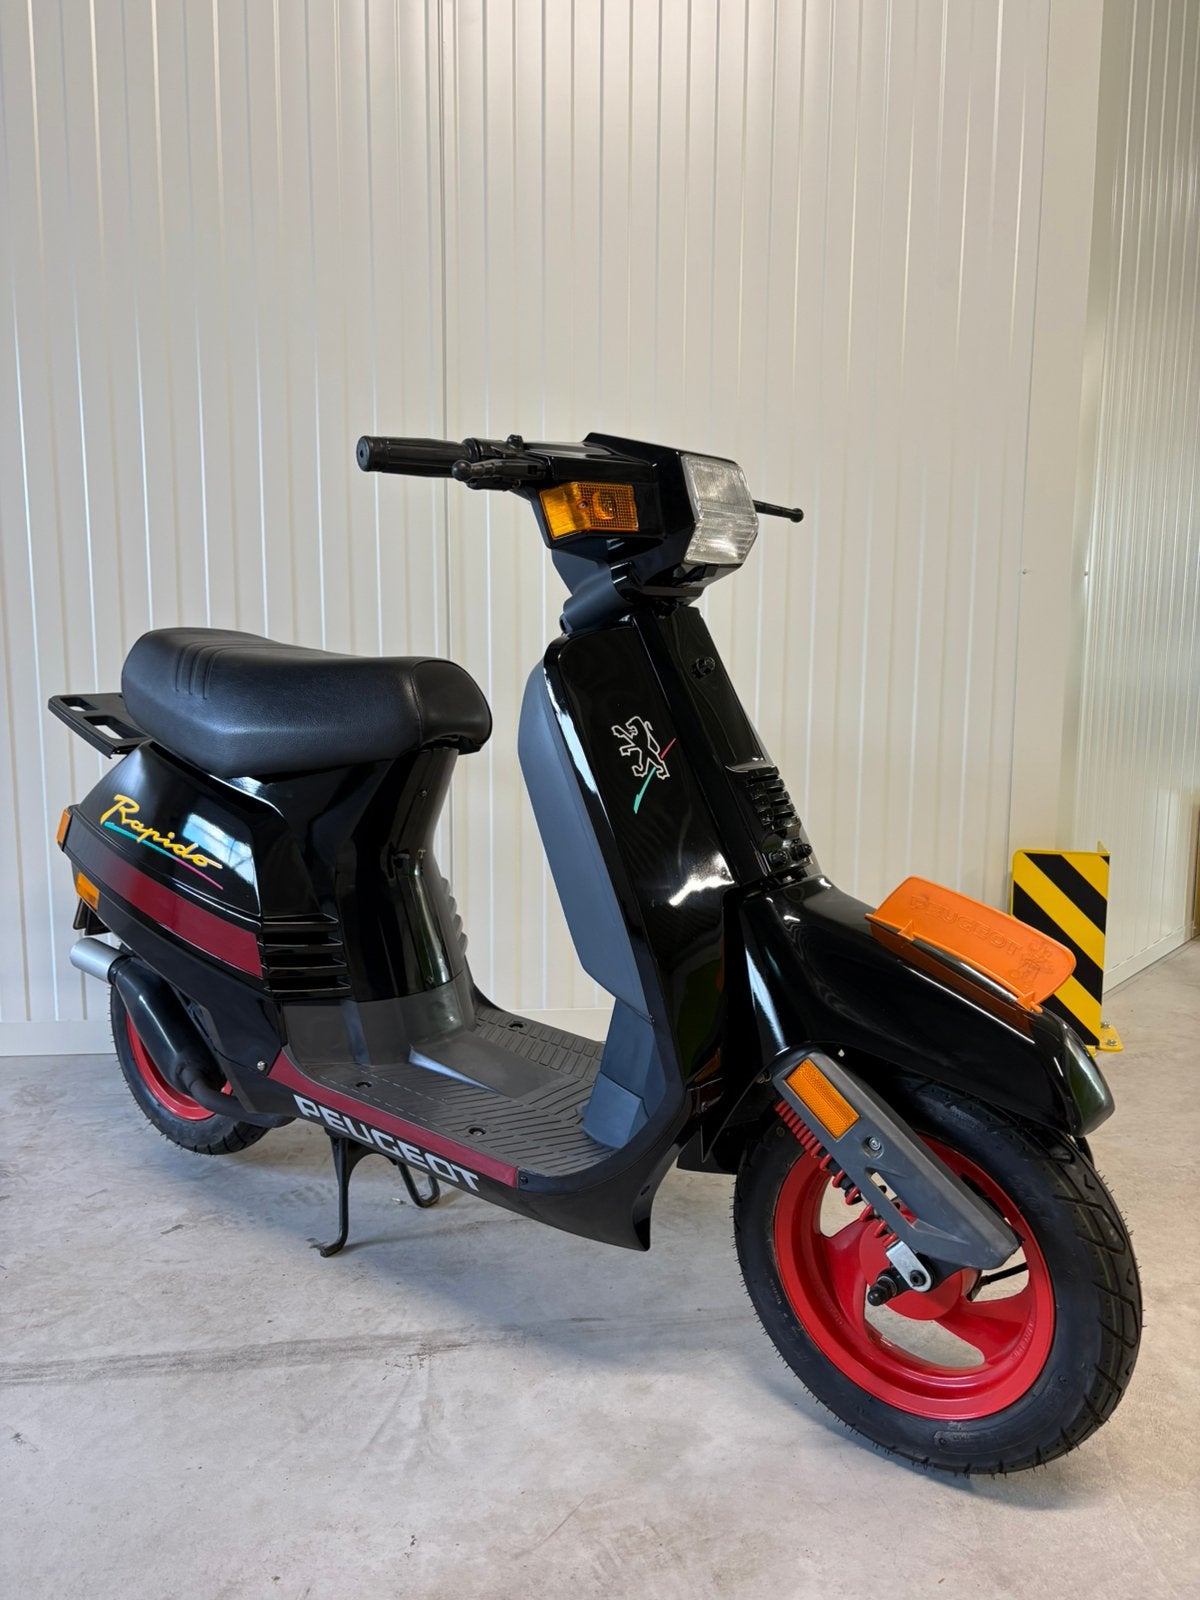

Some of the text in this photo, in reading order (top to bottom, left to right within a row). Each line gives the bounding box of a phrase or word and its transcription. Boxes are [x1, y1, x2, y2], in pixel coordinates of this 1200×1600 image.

[100, 794, 223, 870] Rapido
[909, 894, 1024, 956] PEUGEOT
[292, 1094, 480, 1192] PEUGEOT
